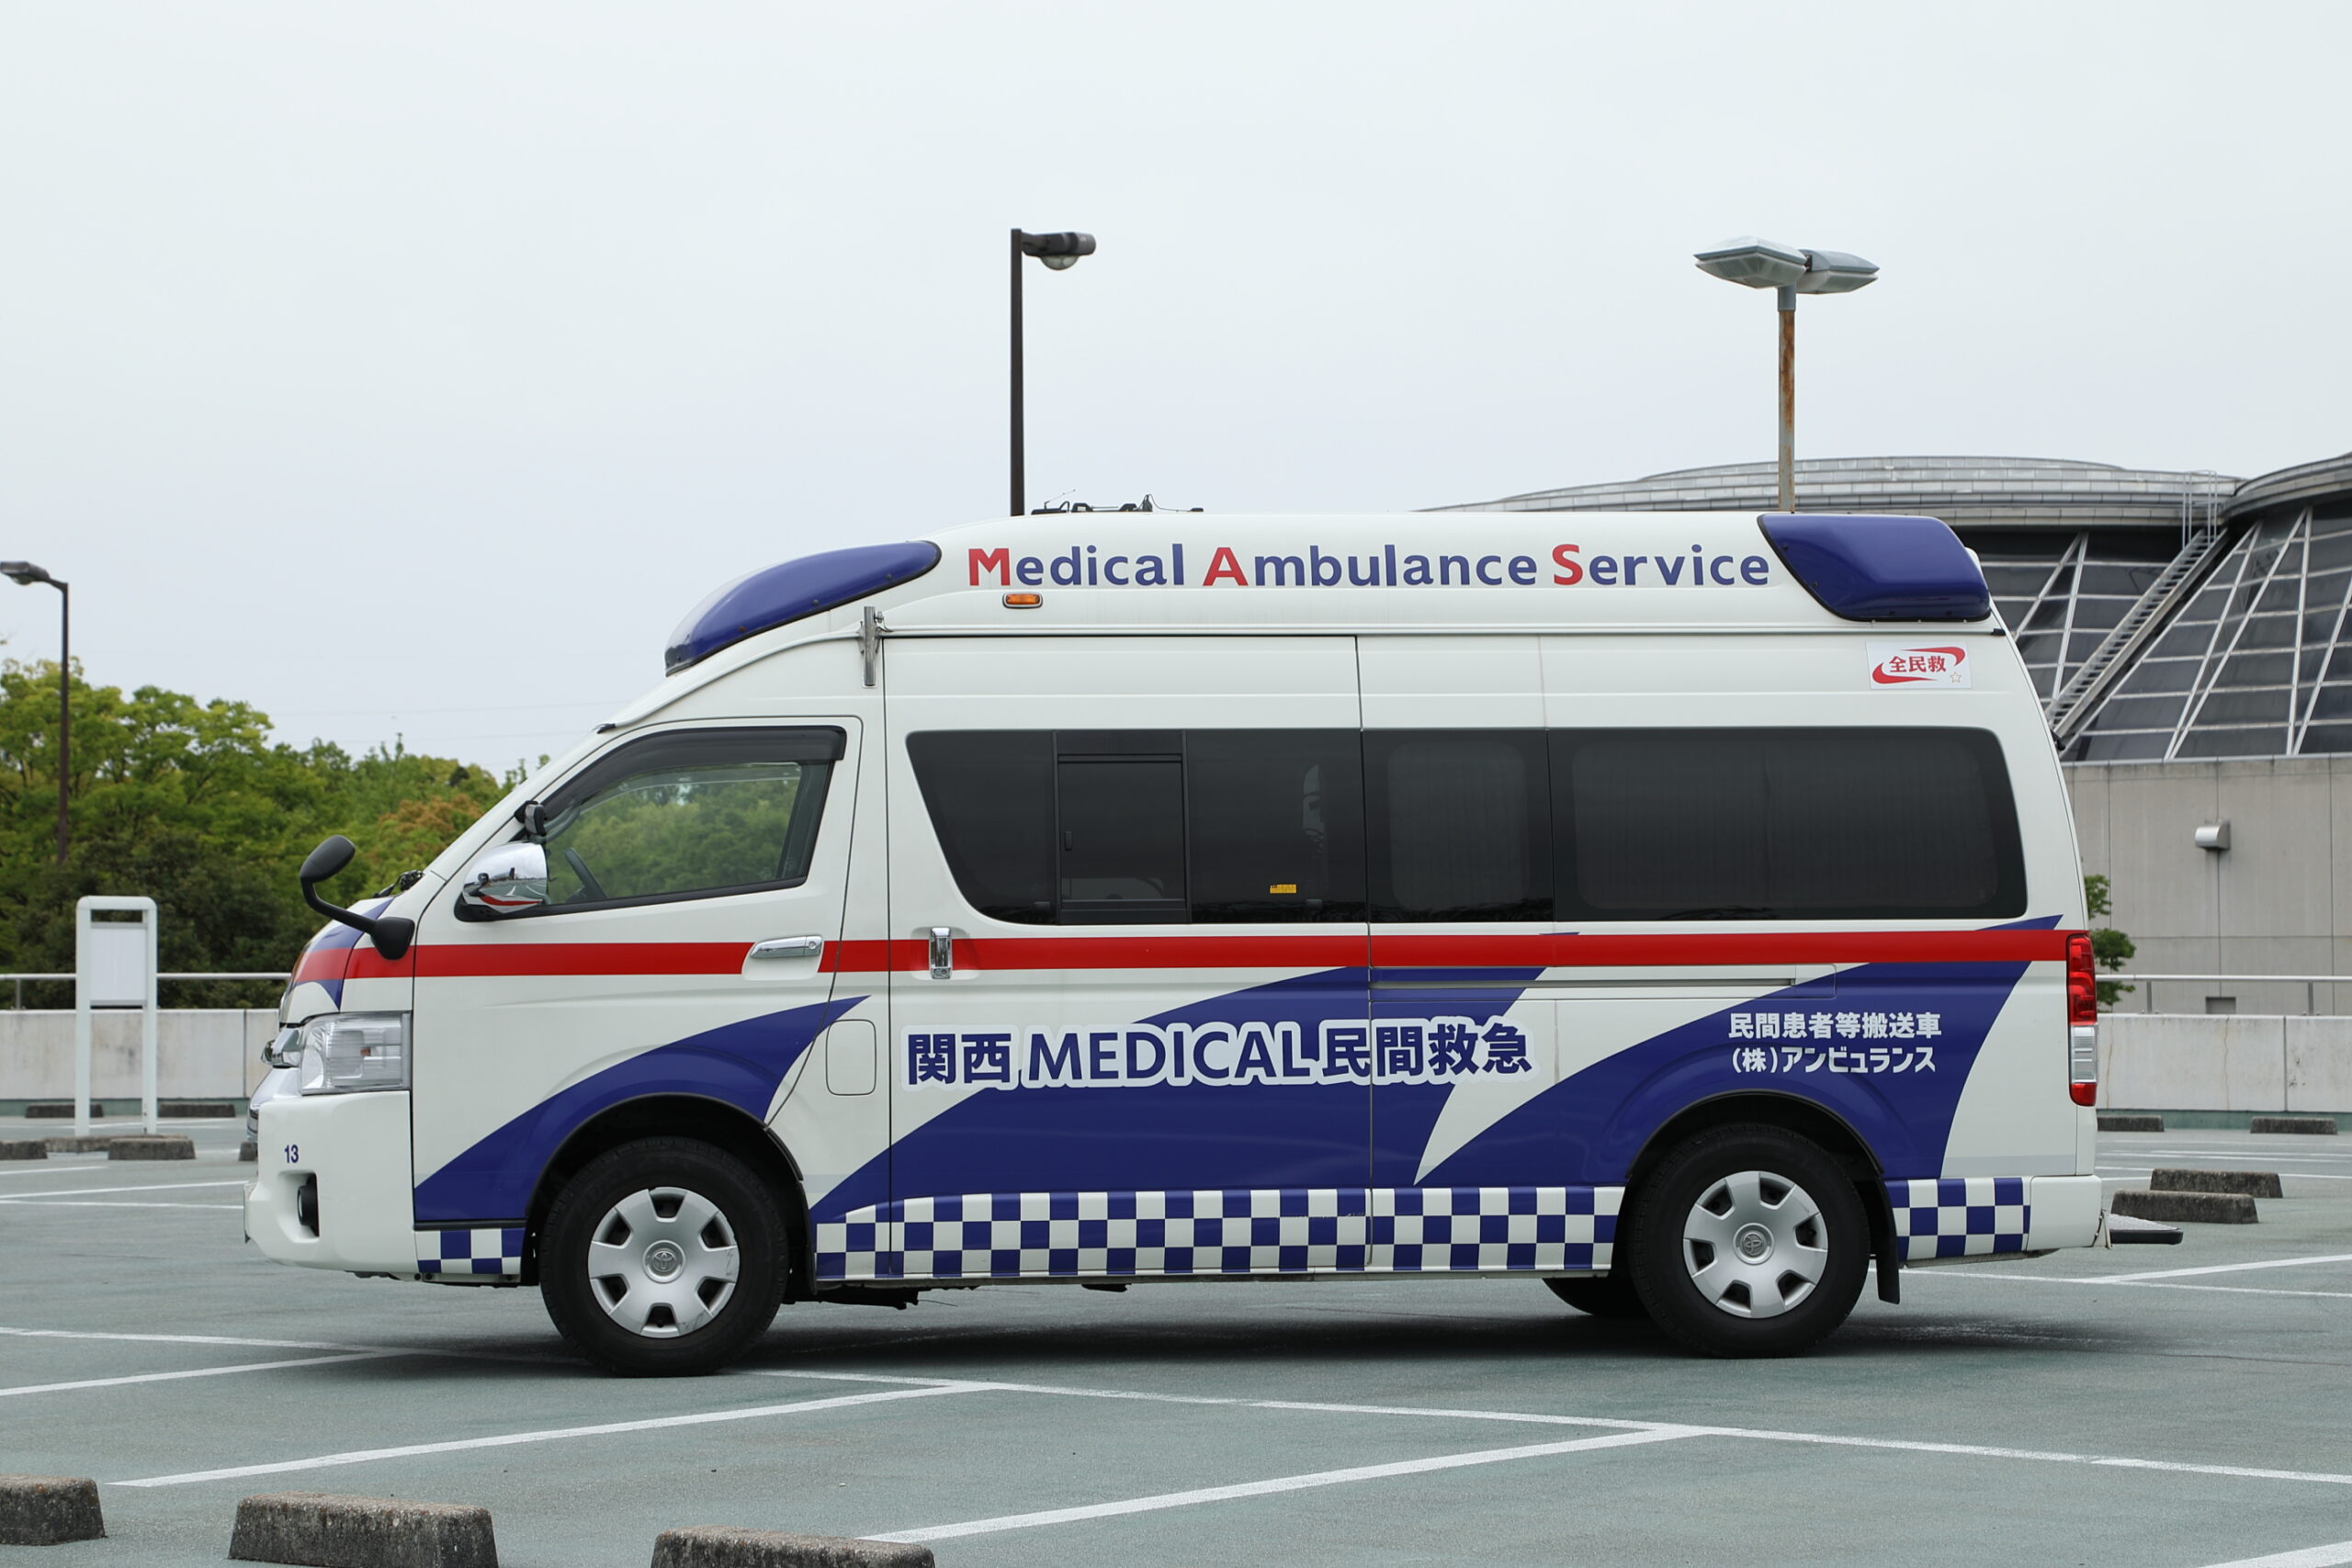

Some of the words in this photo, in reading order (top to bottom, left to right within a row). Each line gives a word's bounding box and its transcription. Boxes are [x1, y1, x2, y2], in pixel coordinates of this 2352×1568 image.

[968, 543, 1184, 586] Medical
[1203, 544, 1538, 586] Ambulance
[1552, 544, 1770, 586] Service
[1888, 655, 1947, 673] 全民救
[1728, 1011, 1942, 1039] 民間患者等搬送車
[907, 1032, 1012, 1085] 関西
[1028, 1030, 1310, 1080] MEDICAL
[1321, 1022, 1532, 1077] 民間救急
[284, 1144, 300, 1164] 13
